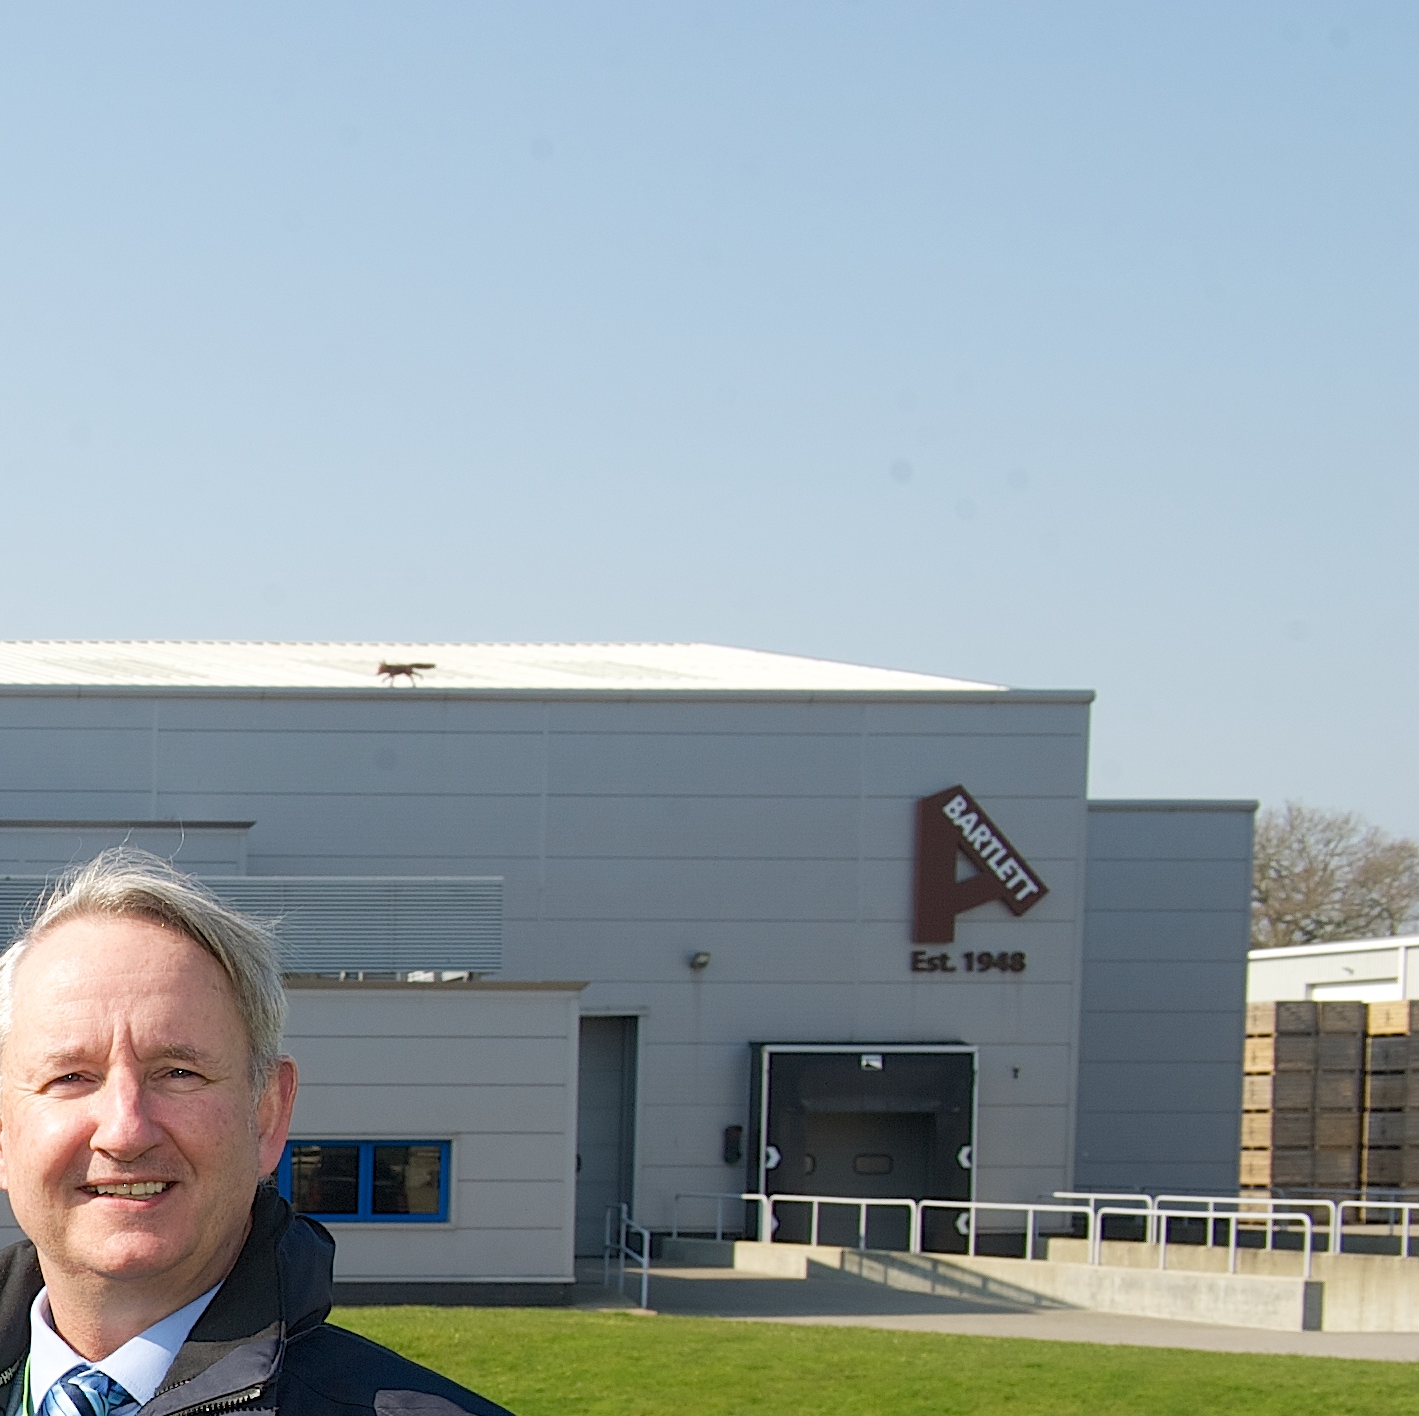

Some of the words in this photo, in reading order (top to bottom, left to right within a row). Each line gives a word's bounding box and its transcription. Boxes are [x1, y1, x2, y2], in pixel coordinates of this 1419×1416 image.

[942, 794, 1039, 901] BARTLETT
[911, 951, 956, 973] Est.
[962, 951, 1027, 973] 1948
